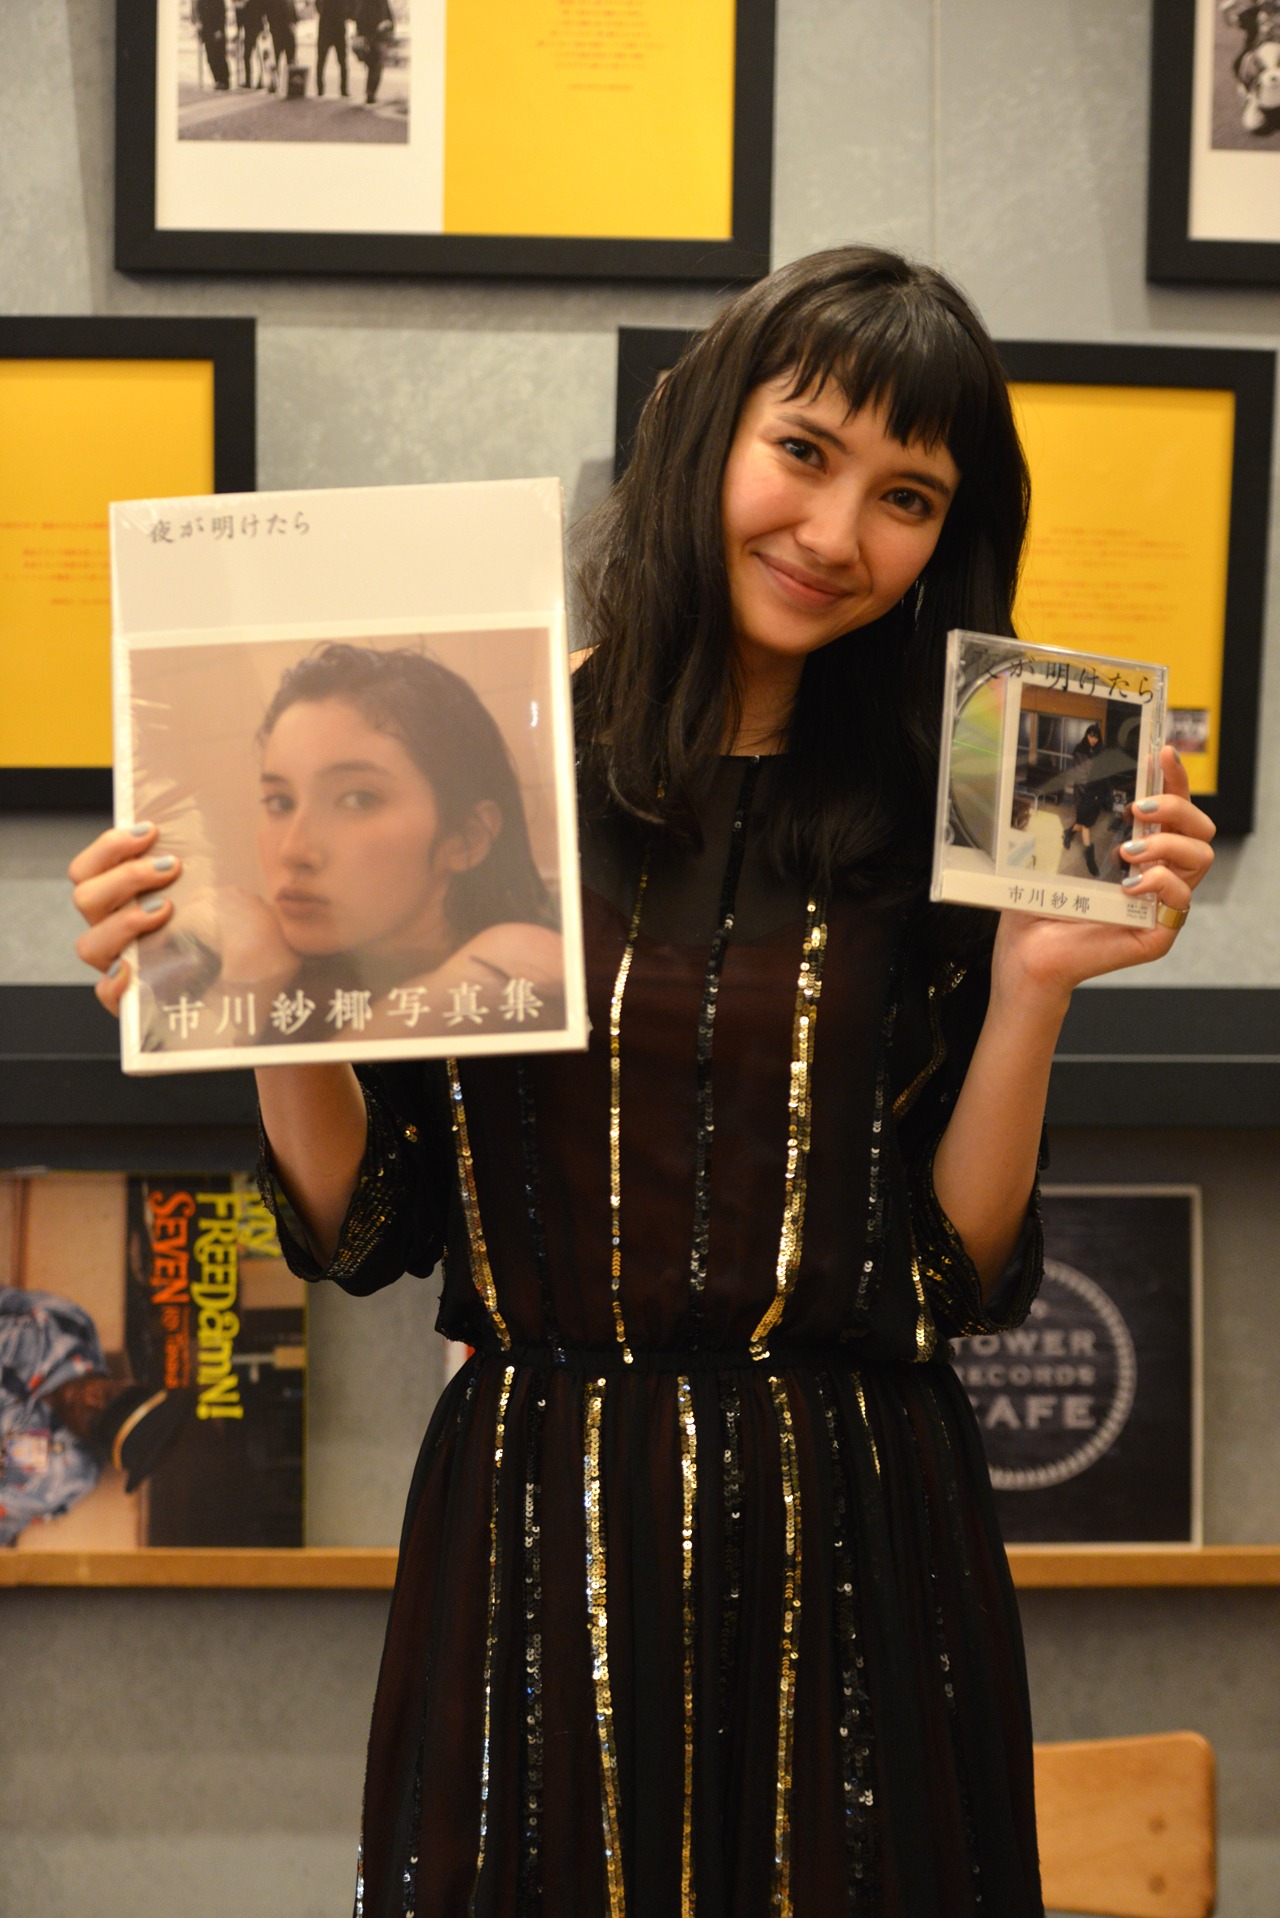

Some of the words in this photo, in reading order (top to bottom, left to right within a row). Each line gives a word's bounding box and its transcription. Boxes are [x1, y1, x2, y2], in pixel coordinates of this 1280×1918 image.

[151, 511, 310, 543] 夜が明けたら
[1008, 885, 1090, 914] 市川紗椰
[163, 978, 543, 1039] 市川紗椰写真集
[150, 1190, 196, 1304] SEVEN
[969, 1394, 1097, 1429] AFE
